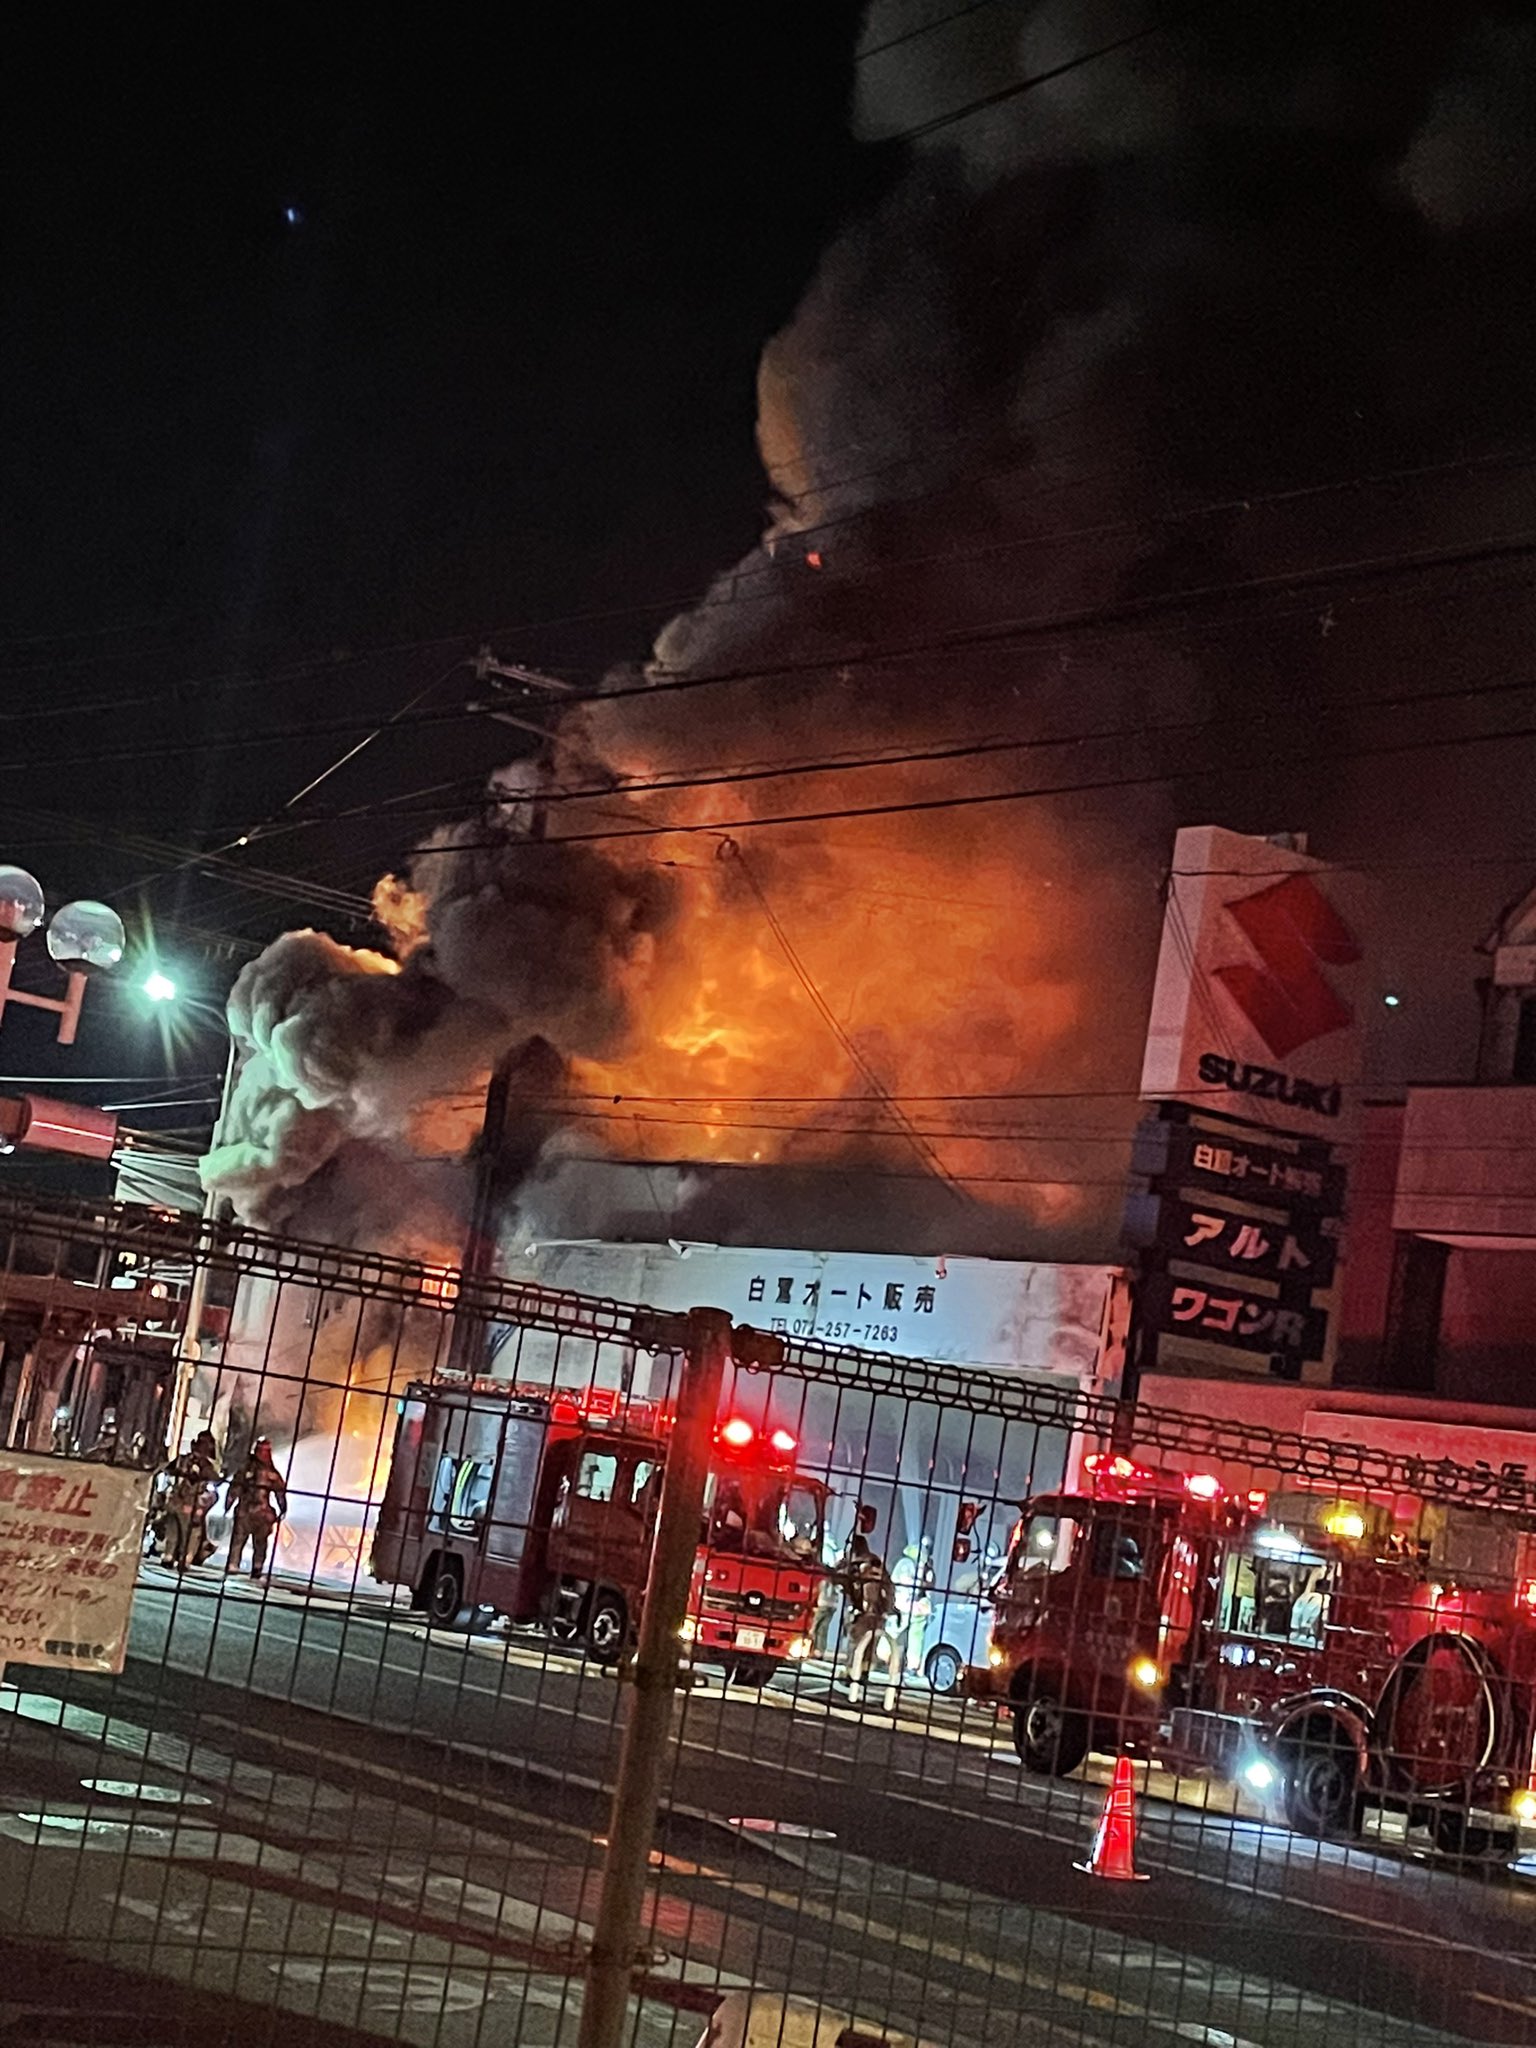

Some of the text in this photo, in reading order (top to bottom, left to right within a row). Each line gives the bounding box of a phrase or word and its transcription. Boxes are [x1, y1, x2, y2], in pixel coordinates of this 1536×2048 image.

[1199, 1053, 1341, 1117] SUZUKI
[1183, 1213, 1311, 1270] アルト
[1171, 1287, 1306, 1346] ワゴンR
